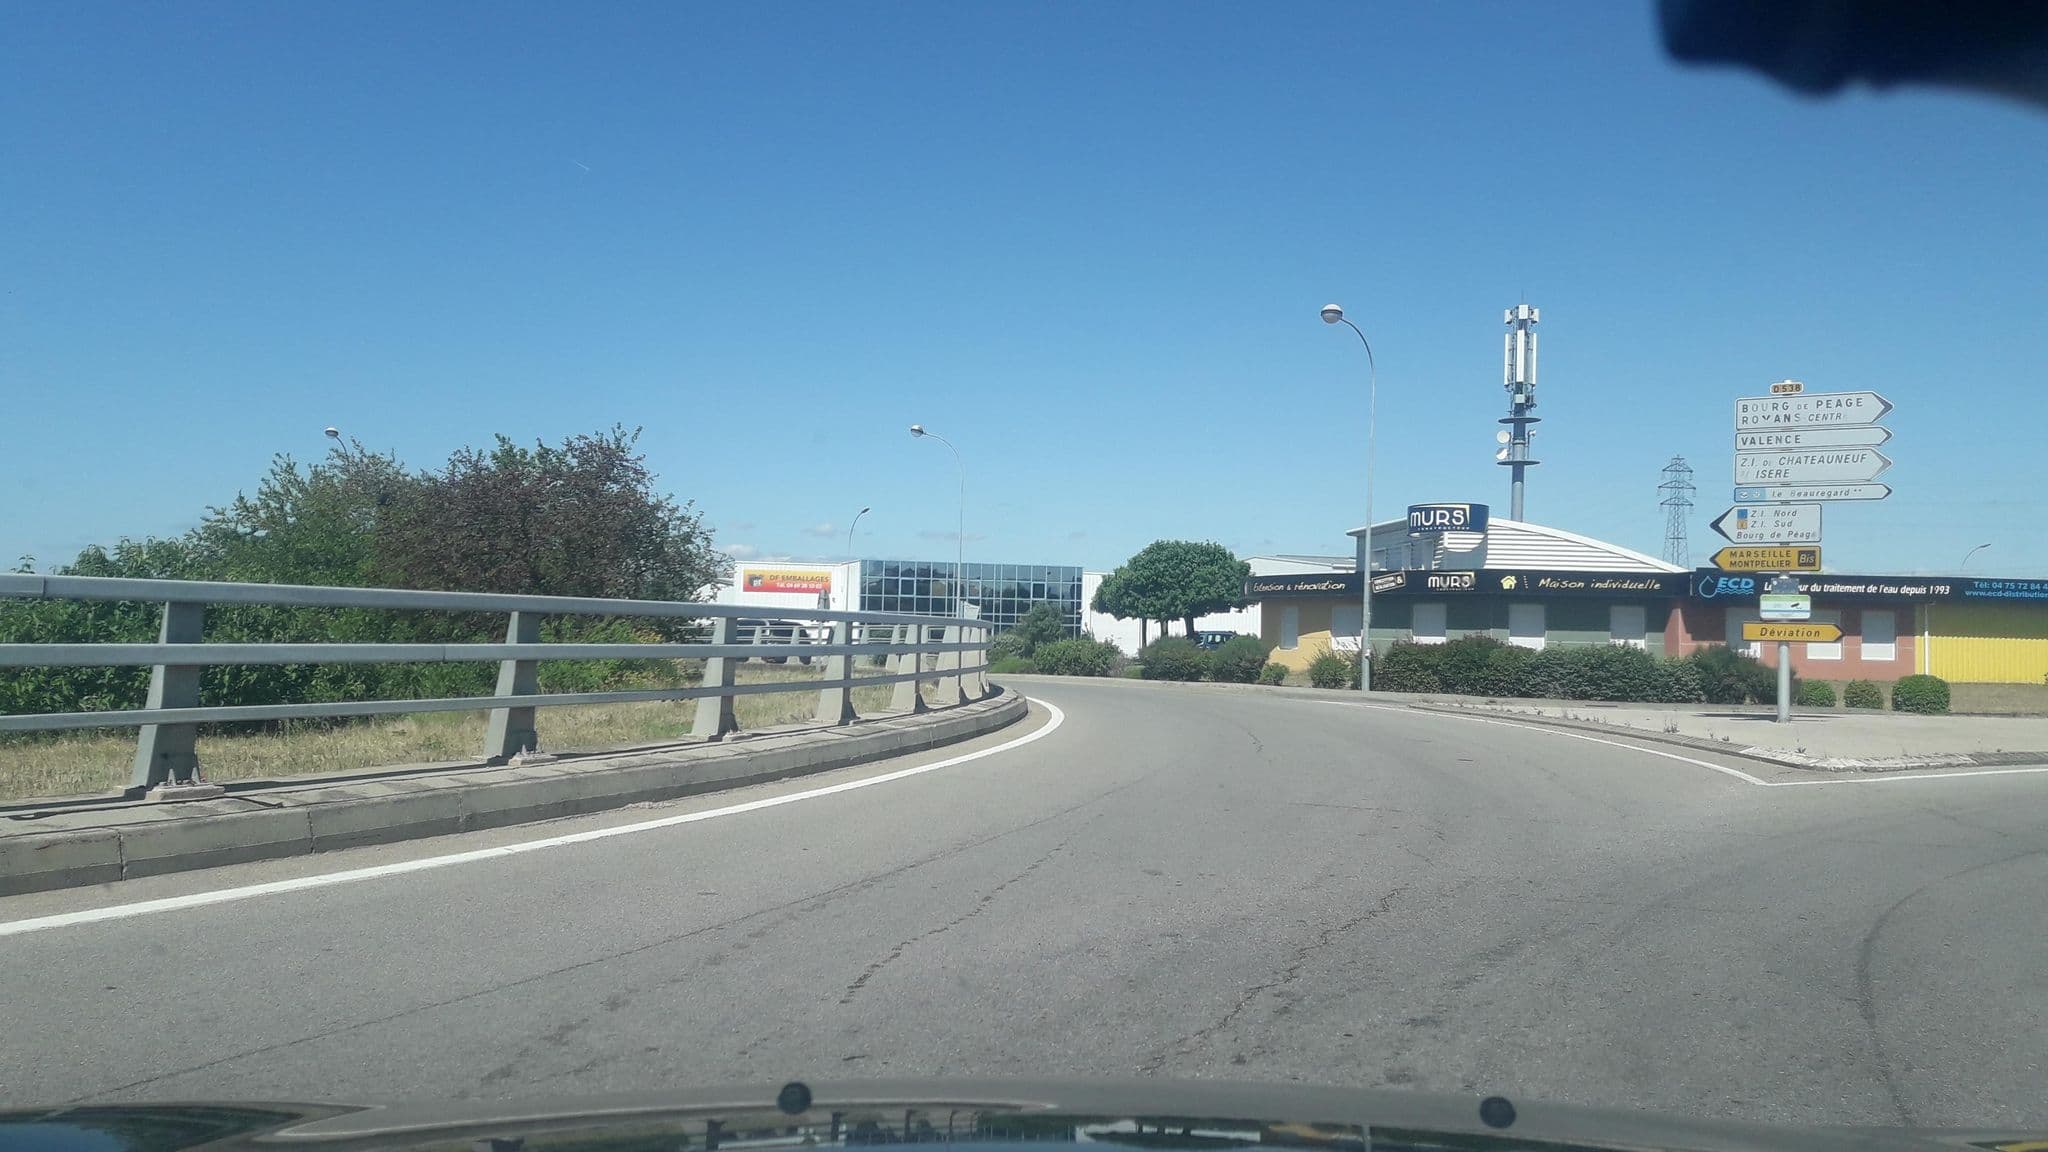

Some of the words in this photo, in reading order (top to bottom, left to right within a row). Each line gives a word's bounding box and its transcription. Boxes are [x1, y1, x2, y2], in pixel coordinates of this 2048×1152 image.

[1742, 401, 1790, 413] BOURG
[1816, 397, 1864, 409] PEAGE
[1741, 434, 1801, 446] VALENCE
[1778, 453, 1868, 466] CHATEAUNEUF
[1755, 468, 1790, 479] ISERE
[1772, 490, 1783, 498] Le
[1790, 488, 1850, 499] Beauregard
[1410, 510, 1465, 528] MURS
[1774, 509, 1798, 517] Nord
[1774, 519, 1794, 528] Sud
[1736, 531, 1765, 540] Bourg
[1770, 531, 1782, 539] de
[1729, 550, 1792, 558] MARSEILLE
[1799, 553, 1816, 564] Bis
[1729, 559, 1792, 568] MONTPELLIER
[1294, 580, 1346, 591] rénovation
[1428, 575, 1471, 588] MURS
[1537, 577, 1585, 588] Maison
[1590, 578, 1662, 590] individuelle
[1716, 577, 1755, 588] ECD
[1810, 583, 1821, 592] du
[1823, 583, 1865, 593] traitement
[1866, 584, 1877, 594] de
[1900, 585, 1926, 597] depuis
[1929, 585, 1950, 595] 1993
[1760, 626, 1821, 638] Déviation
